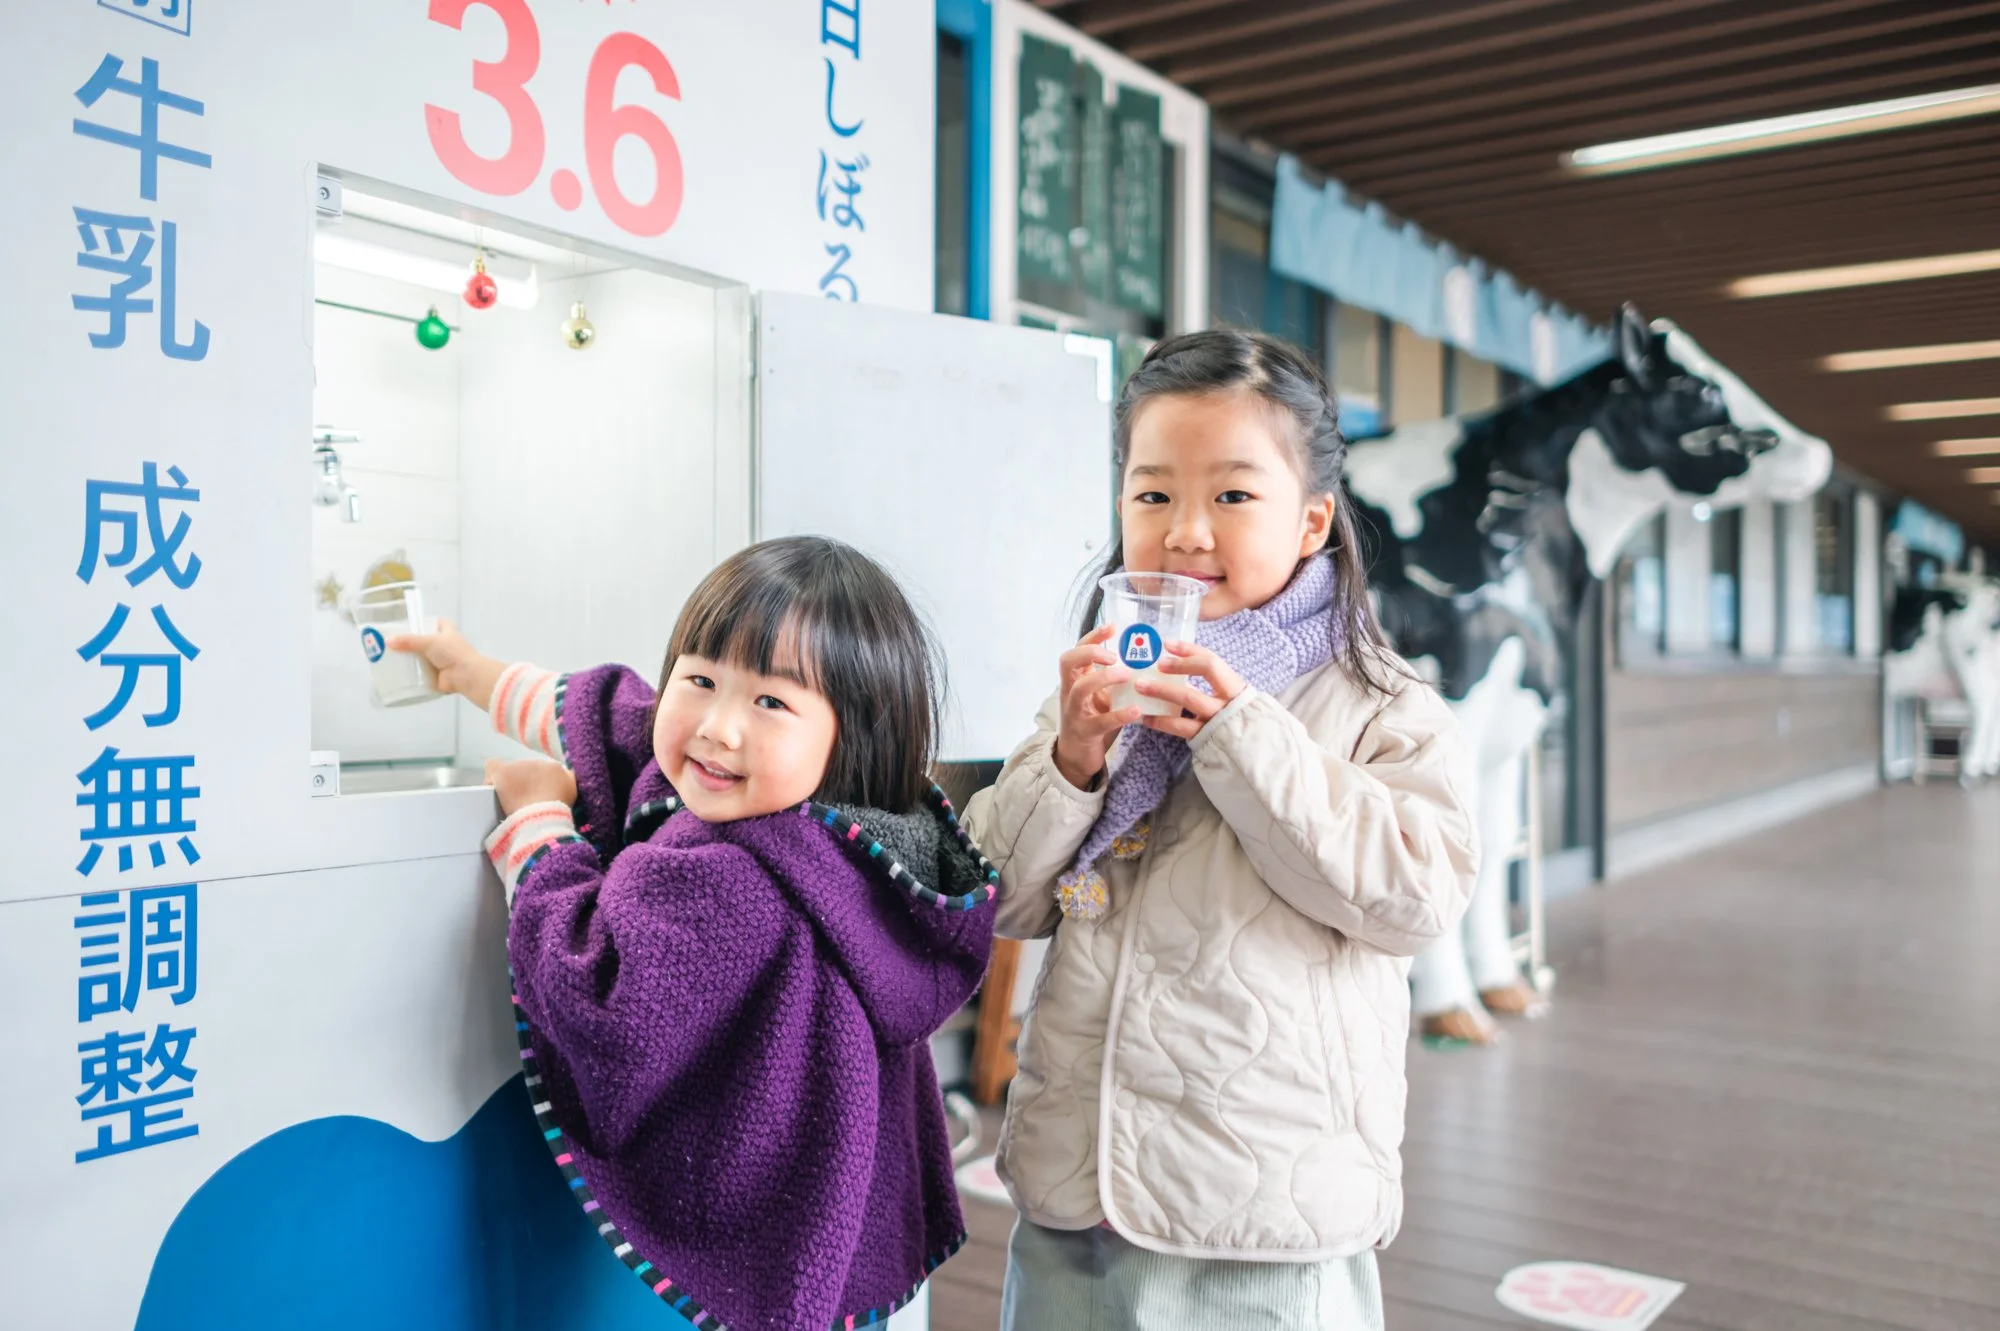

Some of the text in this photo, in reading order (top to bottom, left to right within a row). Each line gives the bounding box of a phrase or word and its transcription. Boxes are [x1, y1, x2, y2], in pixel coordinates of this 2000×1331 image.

[424, 0, 684, 238] 3.6
[71, 52, 212, 1164] 牛乳 成分無調整
